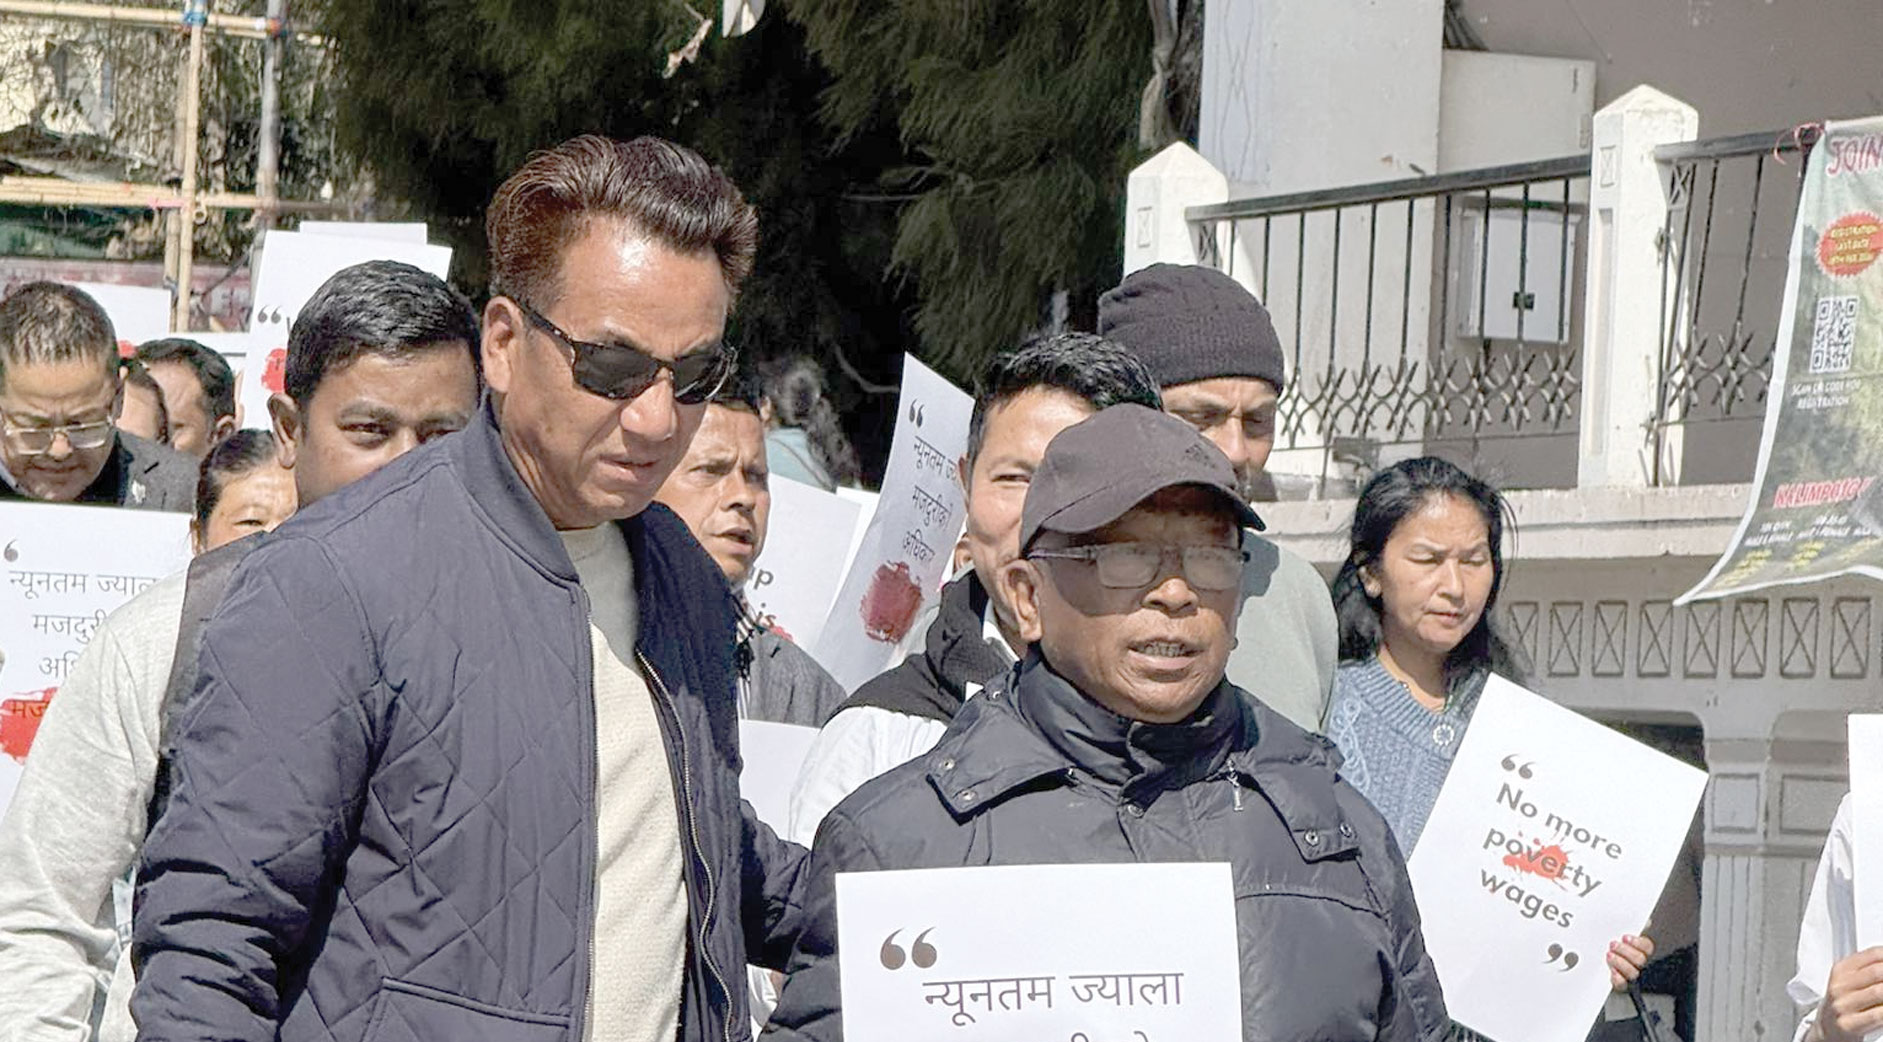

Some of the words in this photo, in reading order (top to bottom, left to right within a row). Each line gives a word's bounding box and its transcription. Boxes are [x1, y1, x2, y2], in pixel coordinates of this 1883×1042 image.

[8, 570, 89, 600] न्यूनतम
[1496, 782, 1539, 819] No
[1545, 812, 1623, 860] more
[1482, 827, 1603, 899] poverty
[1480, 868, 1574, 928] wages
[922, 976, 1056, 1027] न्यूनतम
[1068, 972, 1184, 1006] ज्याला
